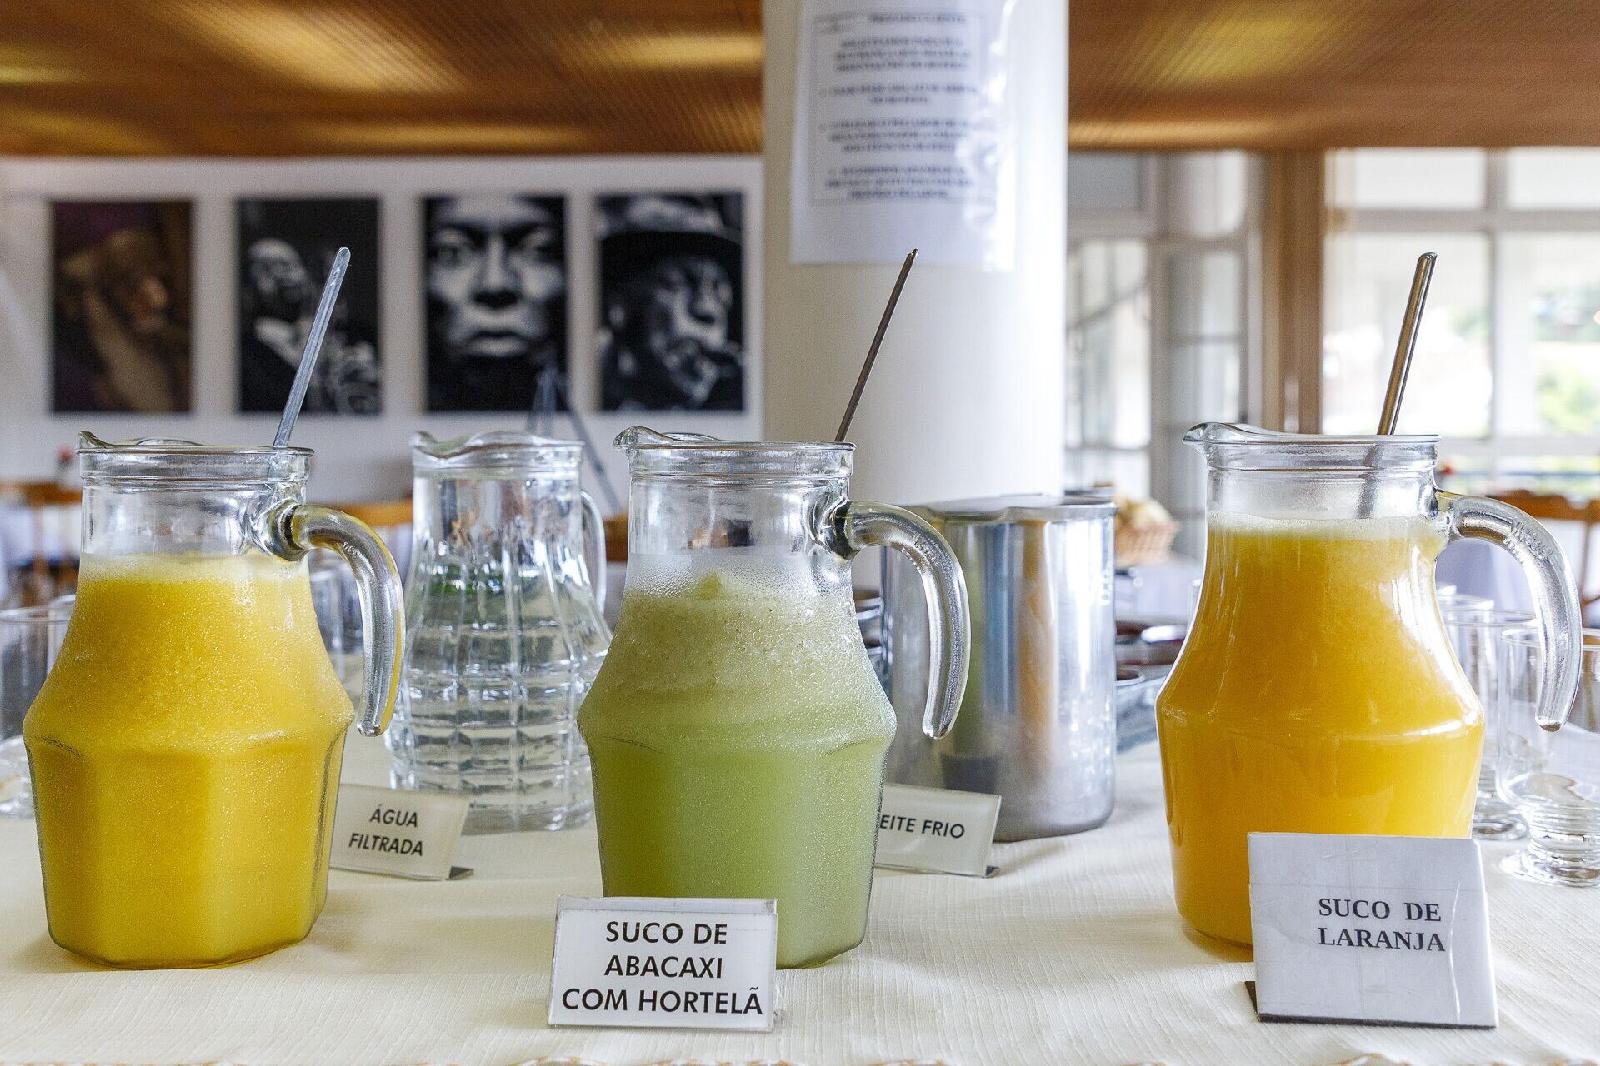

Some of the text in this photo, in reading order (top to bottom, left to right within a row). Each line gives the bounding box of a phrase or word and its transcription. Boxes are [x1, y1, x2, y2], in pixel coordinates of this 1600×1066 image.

[369, 804, 418, 828] ÁGUA
[880, 814, 965, 839] EITE FRIO
[348, 833, 424, 856] FILTRADA
[1318, 898, 1442, 922] SUCO DE
[606, 921, 728, 945] SUCO DE
[1317, 927, 1446, 952] LARANJA
[603, 955, 723, 979] ABACAXI
[562, 986, 763, 1015] COM HORTELÃ
